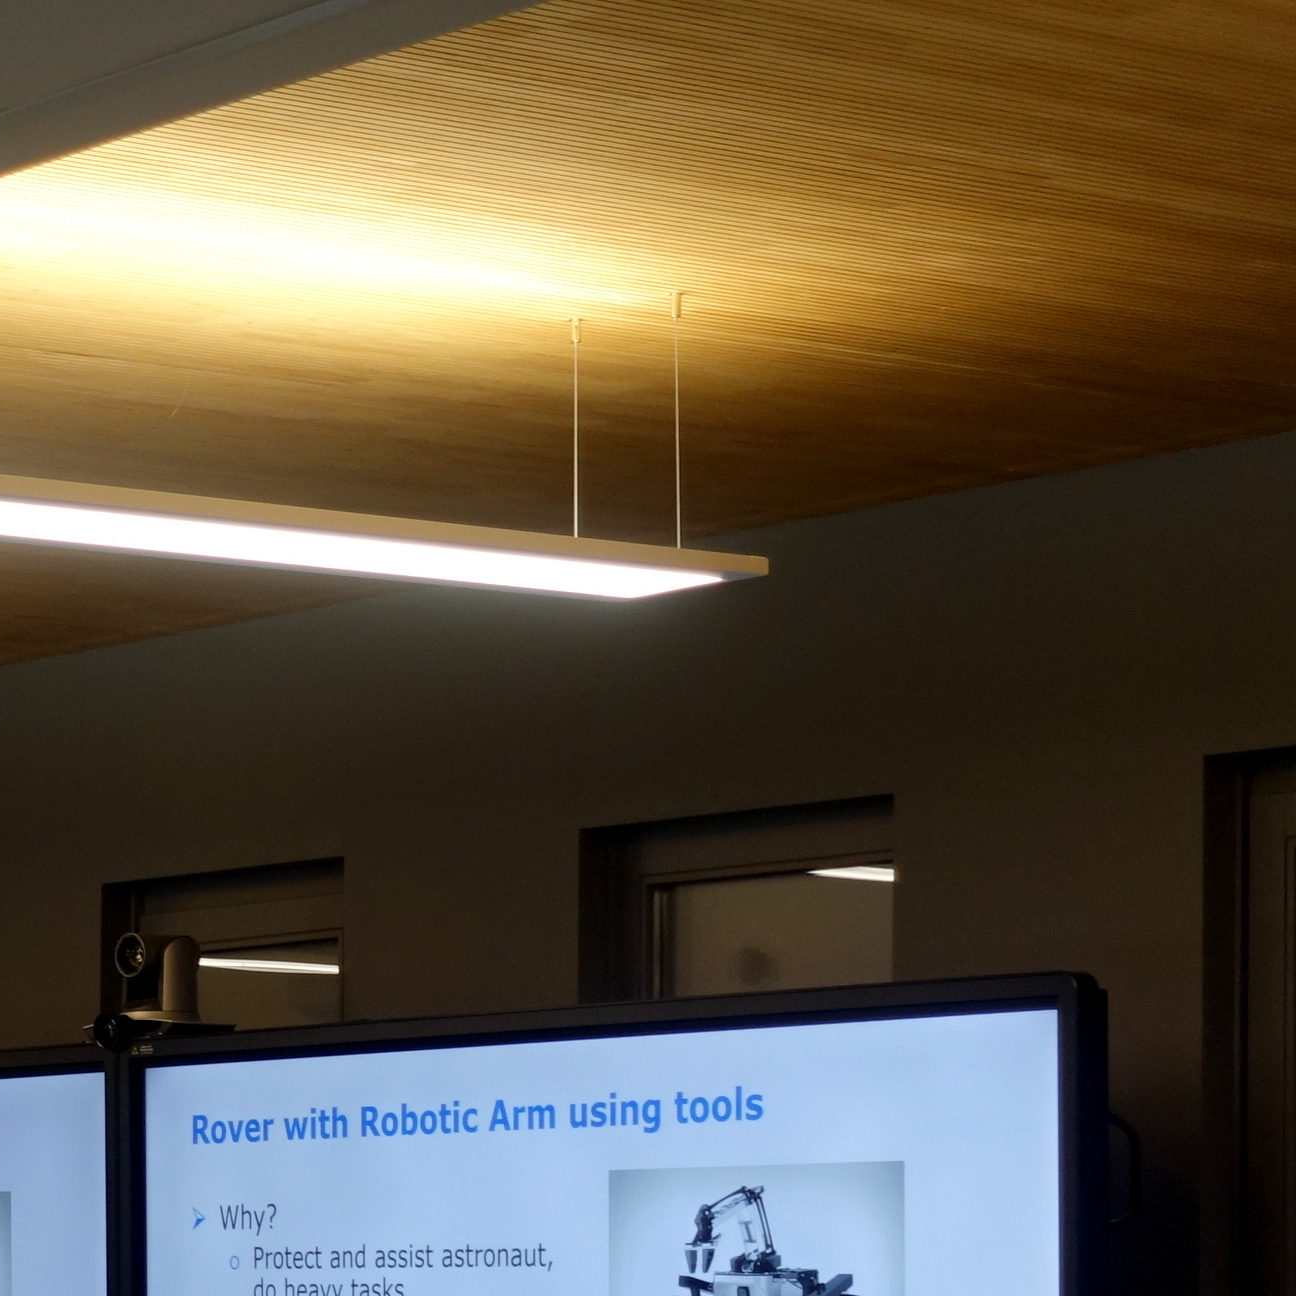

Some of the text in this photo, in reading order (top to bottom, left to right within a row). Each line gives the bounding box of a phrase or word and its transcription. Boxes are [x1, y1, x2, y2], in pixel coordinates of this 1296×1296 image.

[192, 1085, 764, 1144] Rover with Robotic Arm using tools
[219, 1203, 277, 1236] Why?
[253, 1243, 553, 1271] Protect and assist astronaut,
